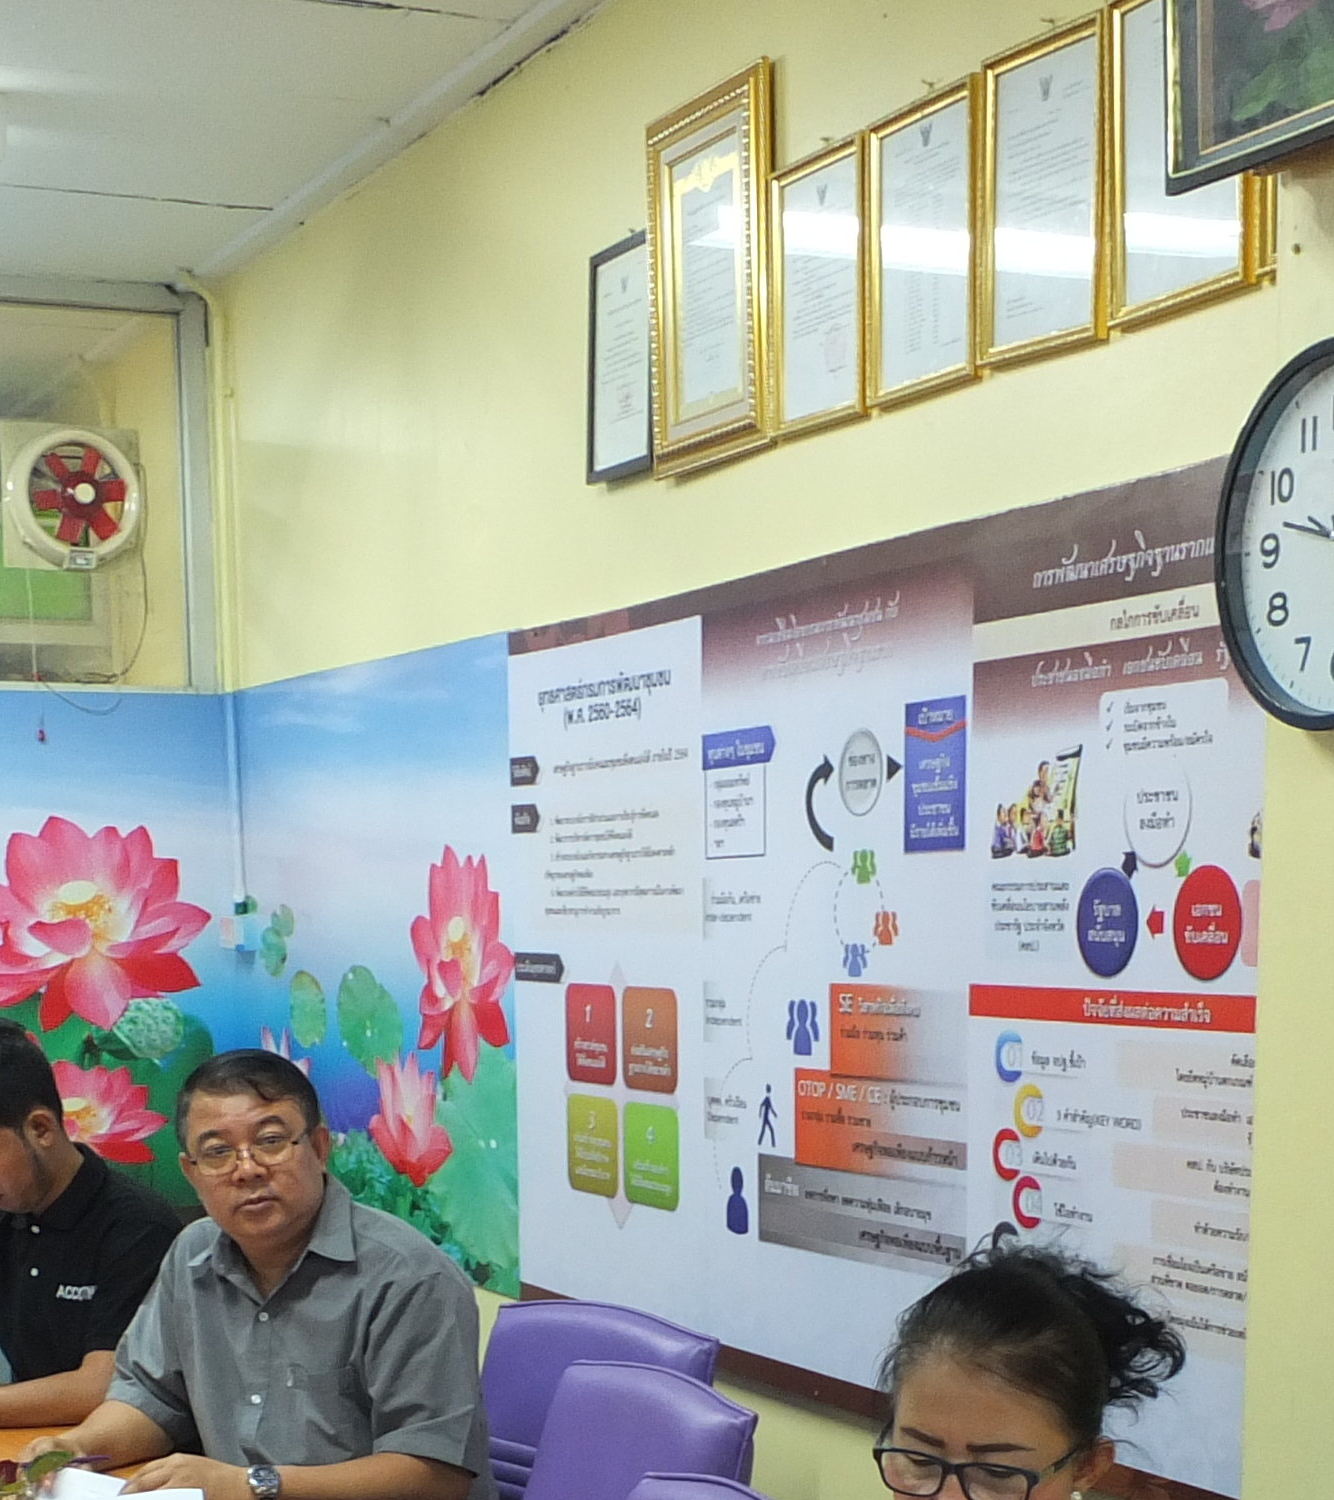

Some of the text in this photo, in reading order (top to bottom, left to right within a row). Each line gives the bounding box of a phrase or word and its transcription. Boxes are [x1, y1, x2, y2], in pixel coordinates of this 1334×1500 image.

[1300, 415, 1318, 453] 11
[1270, 467, 1294, 506] 10
[1260, 532, 1280, 569] 9
[1267, 591, 1289, 627] 8
[1294, 636, 1312, 672] 7
[584, 1004, 593, 1023] 1
[644, 1008, 654, 1029] 2
[798, 1080, 826, 1098] OTOP
